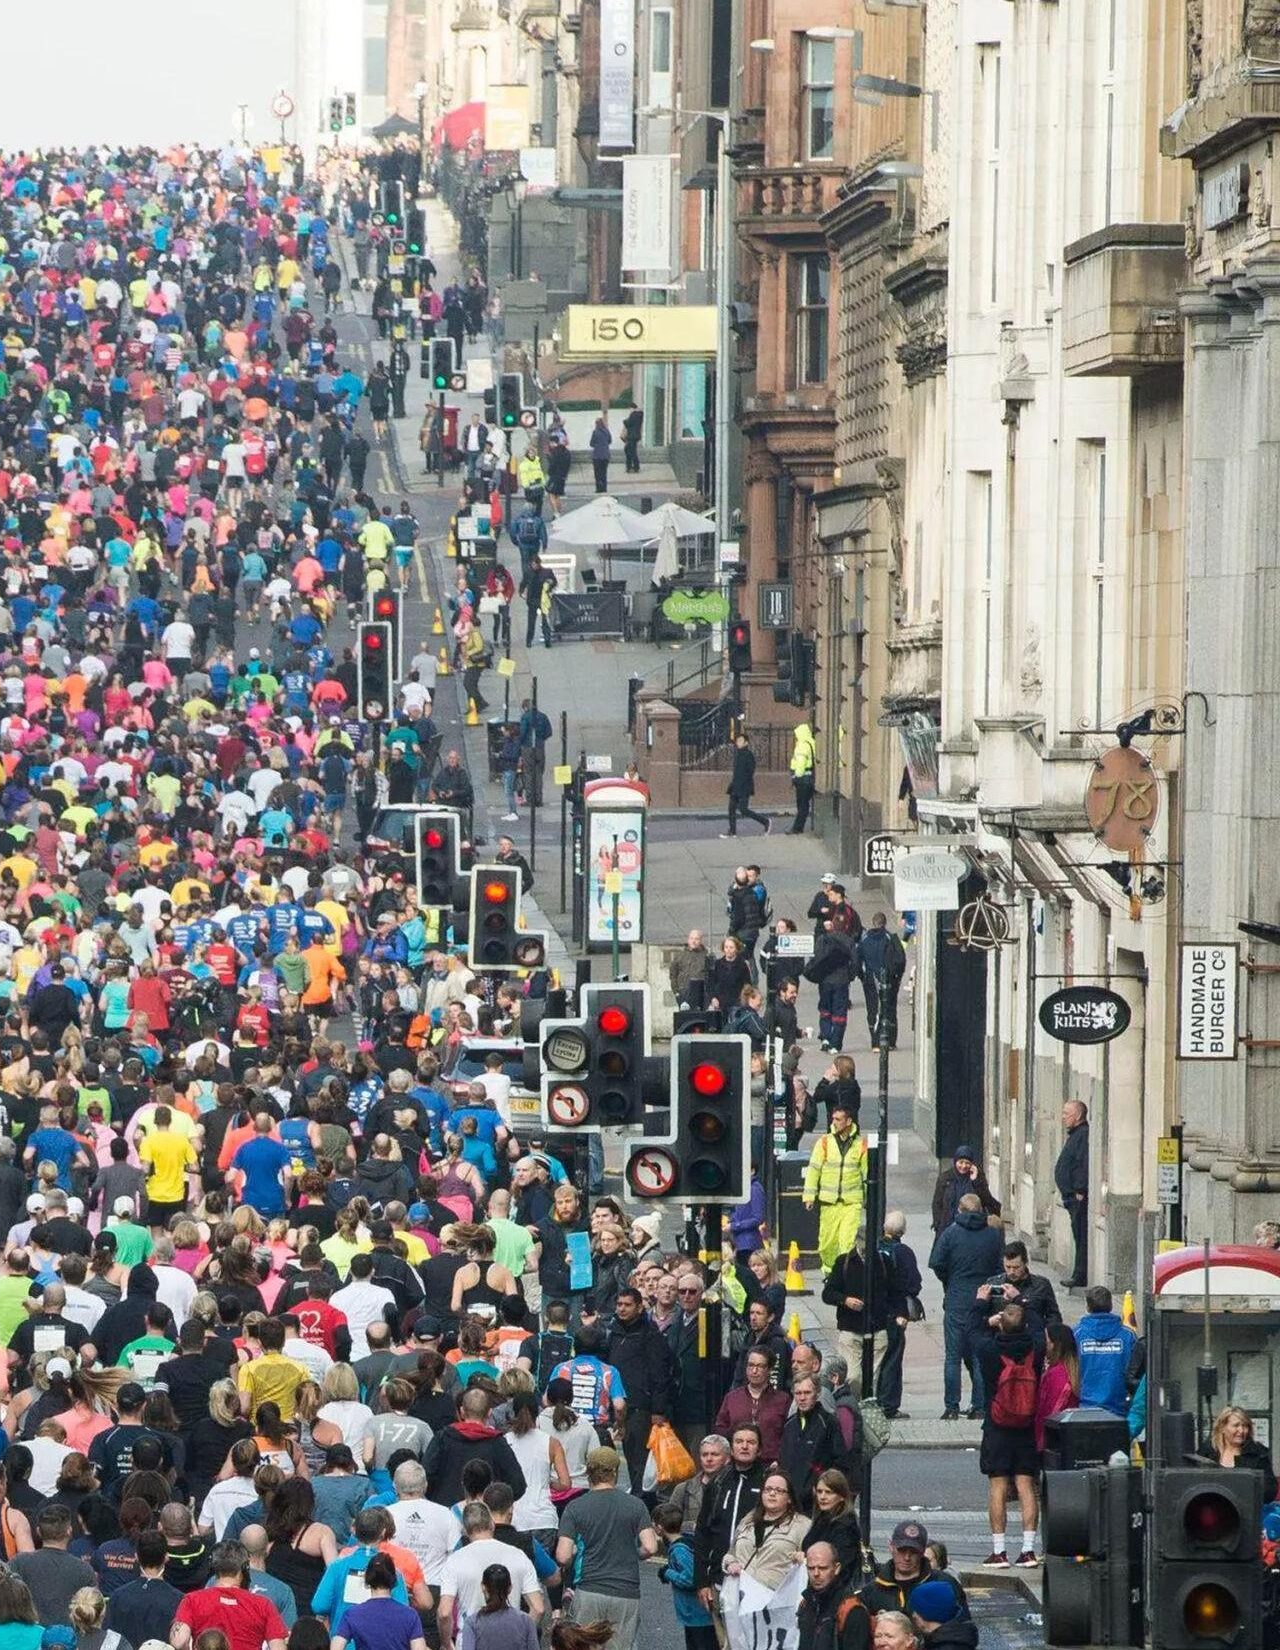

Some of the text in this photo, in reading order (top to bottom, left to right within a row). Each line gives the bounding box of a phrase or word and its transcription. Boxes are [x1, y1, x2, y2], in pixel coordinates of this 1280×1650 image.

[592, 318, 644, 341] 150
[1093, 778, 1154, 826] 78
[1053, 1001, 1091, 1017] SLANJ
[1190, 950, 1207, 1053] HANDMADE
[1210, 978, 1225, 1053] BURGER
[1054, 1015, 1091, 1030] KILTS
